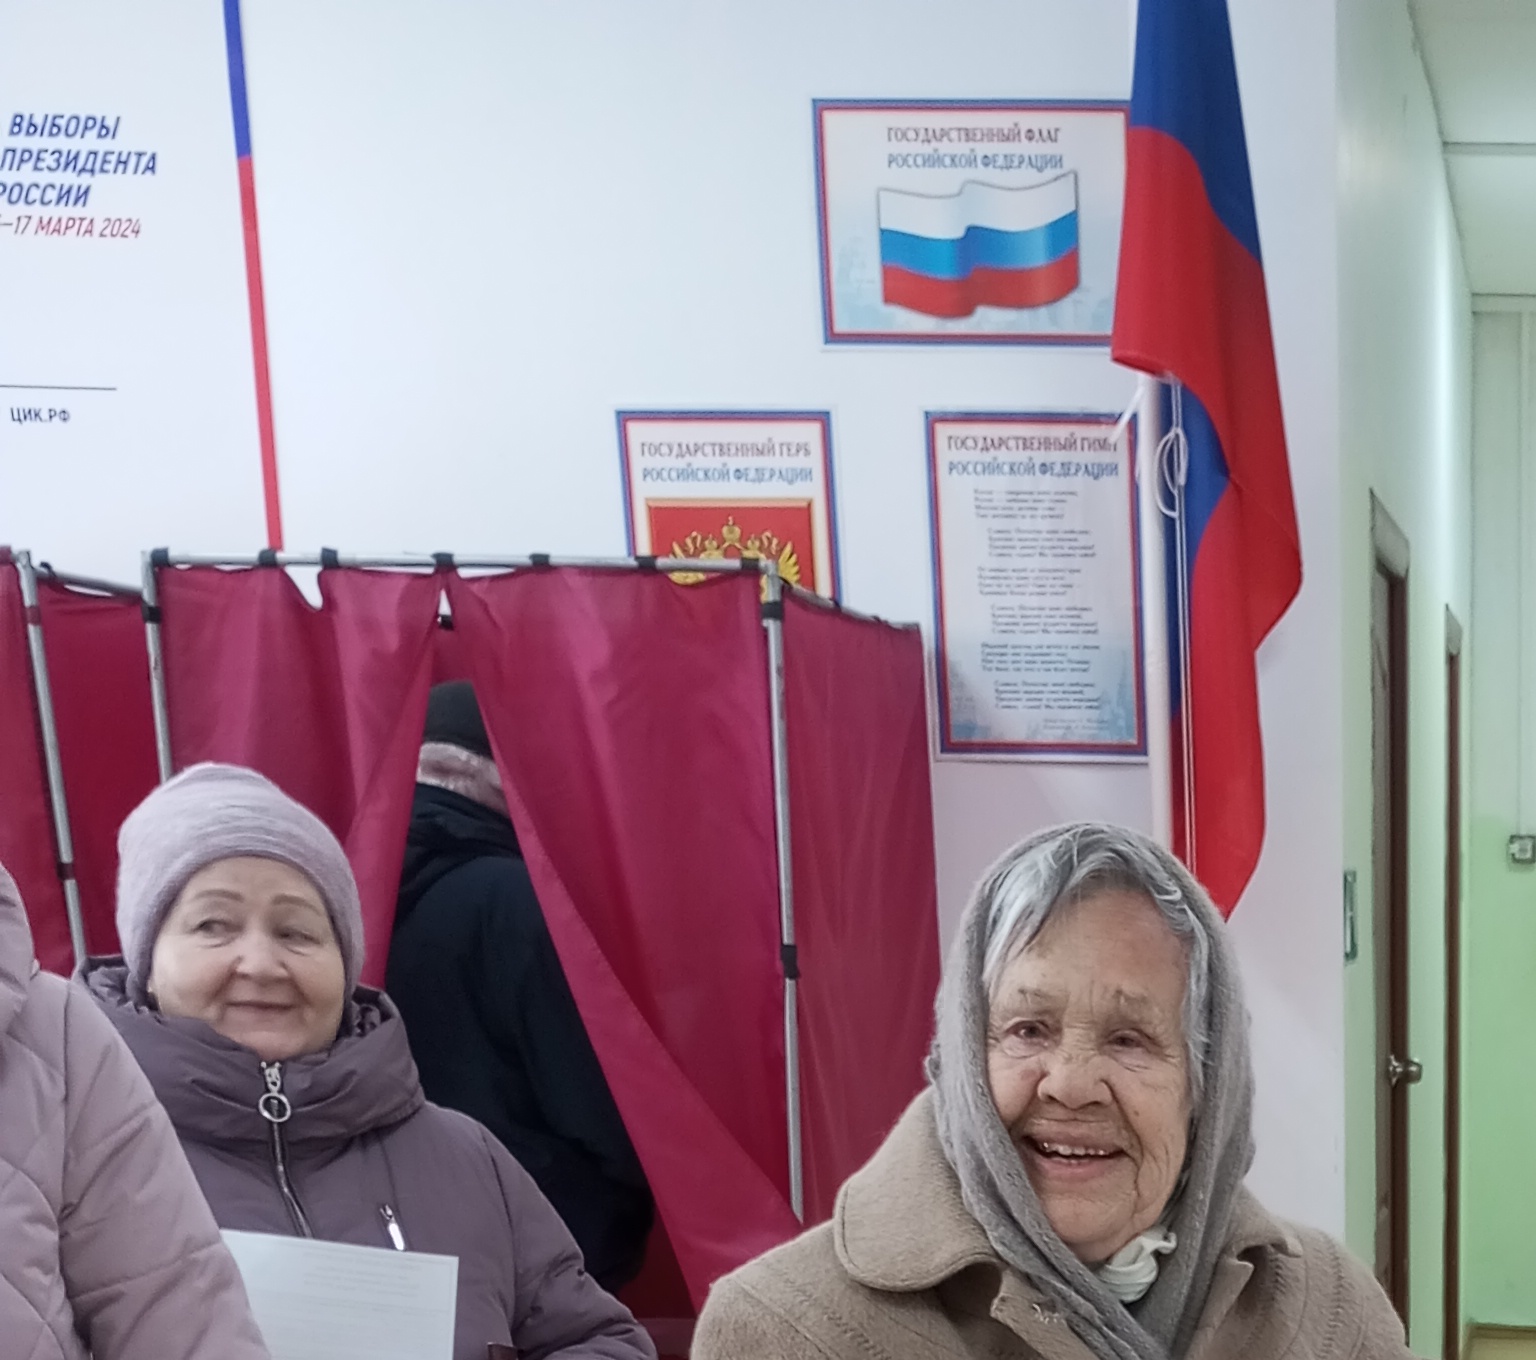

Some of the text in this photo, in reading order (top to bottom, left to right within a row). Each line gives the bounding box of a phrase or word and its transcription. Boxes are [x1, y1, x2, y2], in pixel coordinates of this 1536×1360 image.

[8, 112, 121, 140] ВЫБОРЫ
[887, 122, 1061, 145] ГОСУДАРСТВЕННЫЙ ФЛАГ
[0, 147, 157, 178] ПРЕЗИДЕНТА
[887, 148, 1064, 173] РОССИЙСКОЙ ФЕДЕРАЦИИ
[34, 216, 95, 237] МАРТА
[98, 217, 142, 239] 2024
[640, 437, 812, 459] ГОСУДАРСТВЕННЫЙ ГЕРБ
[947, 432, 1077, 453] ГОСУДАРСТВЕННЫЙ
[642, 462, 813, 486] РОССИЙСКОЙ ФЕДЕРАЦИИ
[949, 456, 1118, 481] РОССИЙСКОЙ ФЕДЕРАЦИИ
